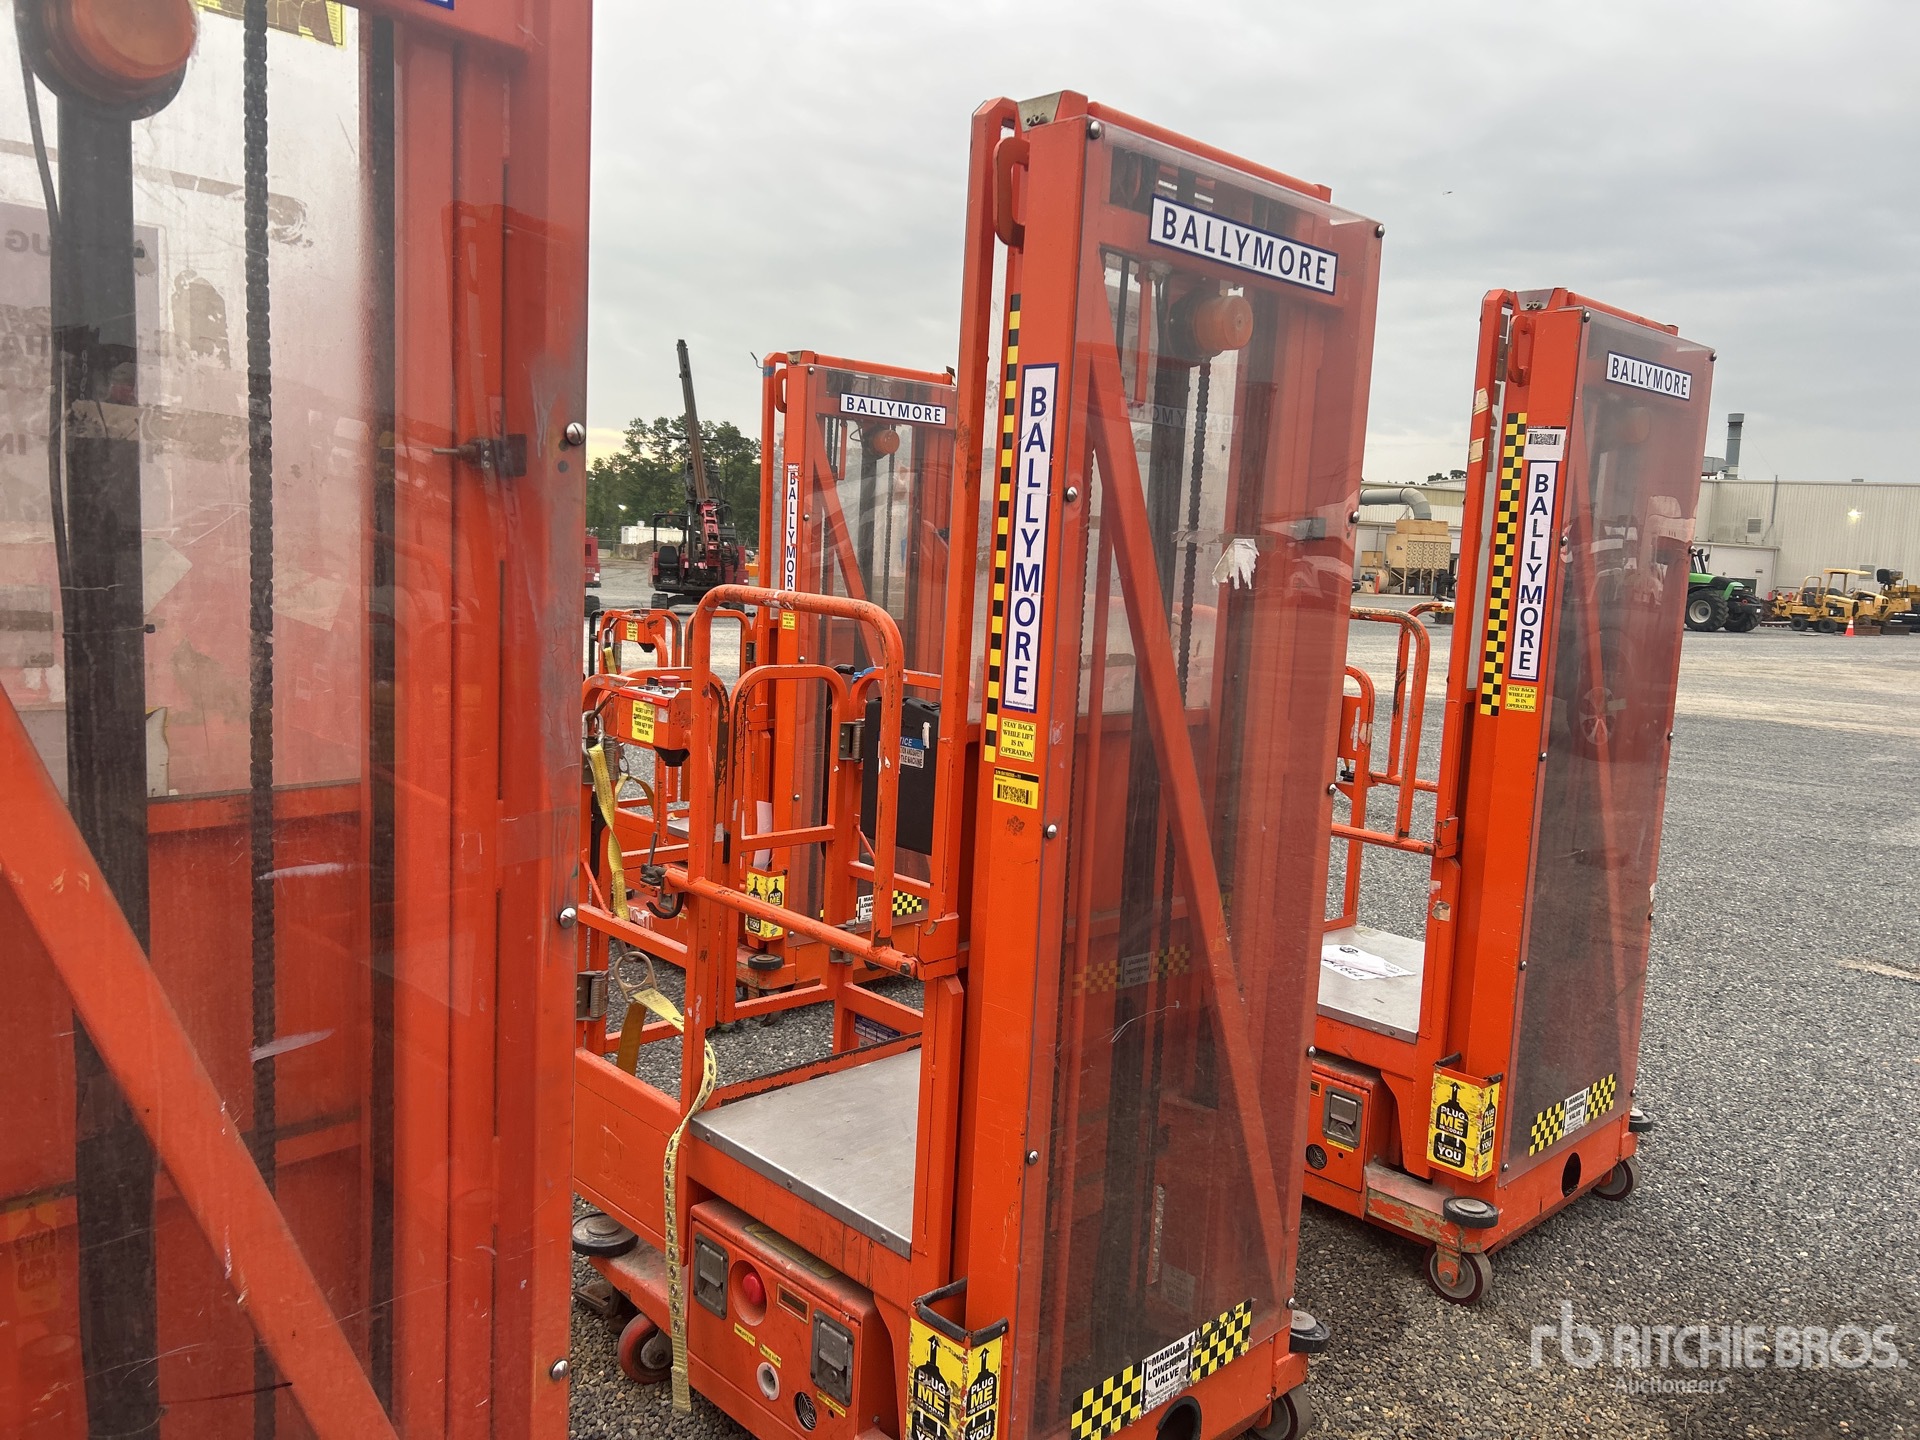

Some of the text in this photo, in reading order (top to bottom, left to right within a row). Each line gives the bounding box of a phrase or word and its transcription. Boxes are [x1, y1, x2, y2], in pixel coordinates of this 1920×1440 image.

[1162, 206, 1328, 286] BALLYMORE
[1611, 357, 1688, 396] BALLYMORE
[846, 396, 941, 422] BALLYMORE
[786, 472, 797, 591] BALLYMOR
[1013, 386, 1047, 695] BALLYMORE
[1519, 473, 1549, 671] BALLYMORE
[1002, 729, 1034, 740] WHILE LIFT
[1003, 721, 1034, 732] STAY BACK
[1000, 746, 1033, 758] OPERATION
[1439, 1113, 1465, 1132] ME
[1440, 1105, 1466, 1121] PLUG
[1484, 1113, 1494, 1126] ME
[1437, 1146, 1462, 1161] YOU
[1481, 1139, 1492, 1151] YOU
[918, 1369, 946, 1395] PLUG
[971, 1376, 994, 1395] PLUG
[1154, 1367, 1180, 1388] VALVE
[917, 1383, 945, 1414] ME
[970, 1385, 993, 1409] ME
[976, 1398, 993, 1411] TODAY
